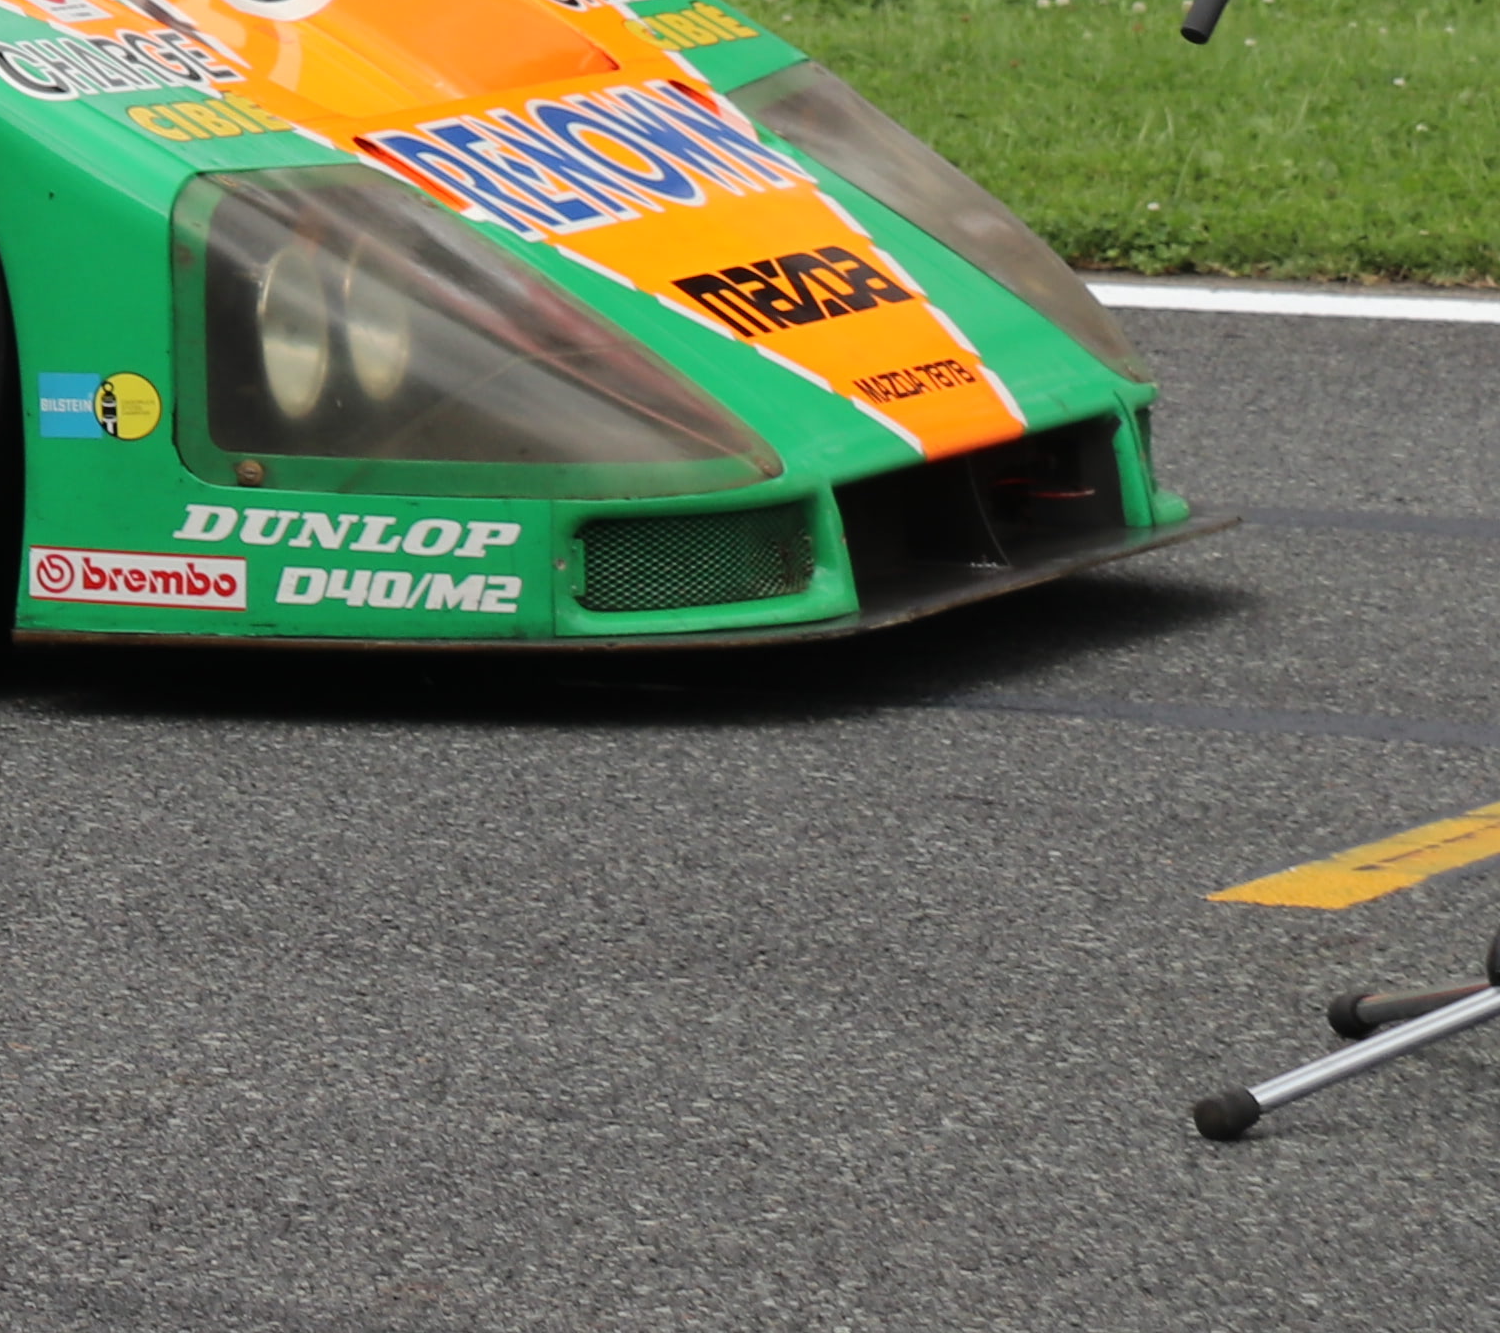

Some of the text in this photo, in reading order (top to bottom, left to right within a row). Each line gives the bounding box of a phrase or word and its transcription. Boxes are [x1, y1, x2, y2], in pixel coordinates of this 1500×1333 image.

[366, 78, 819, 243] RENOWN
[40, 397, 94, 412] BILSTEIN
[852, 358, 976, 405] MAZDA 787B
[172, 503, 522, 559] DUNLOP
[82, 557, 238, 598] brembo
[275, 566, 523, 614] D40/M2
